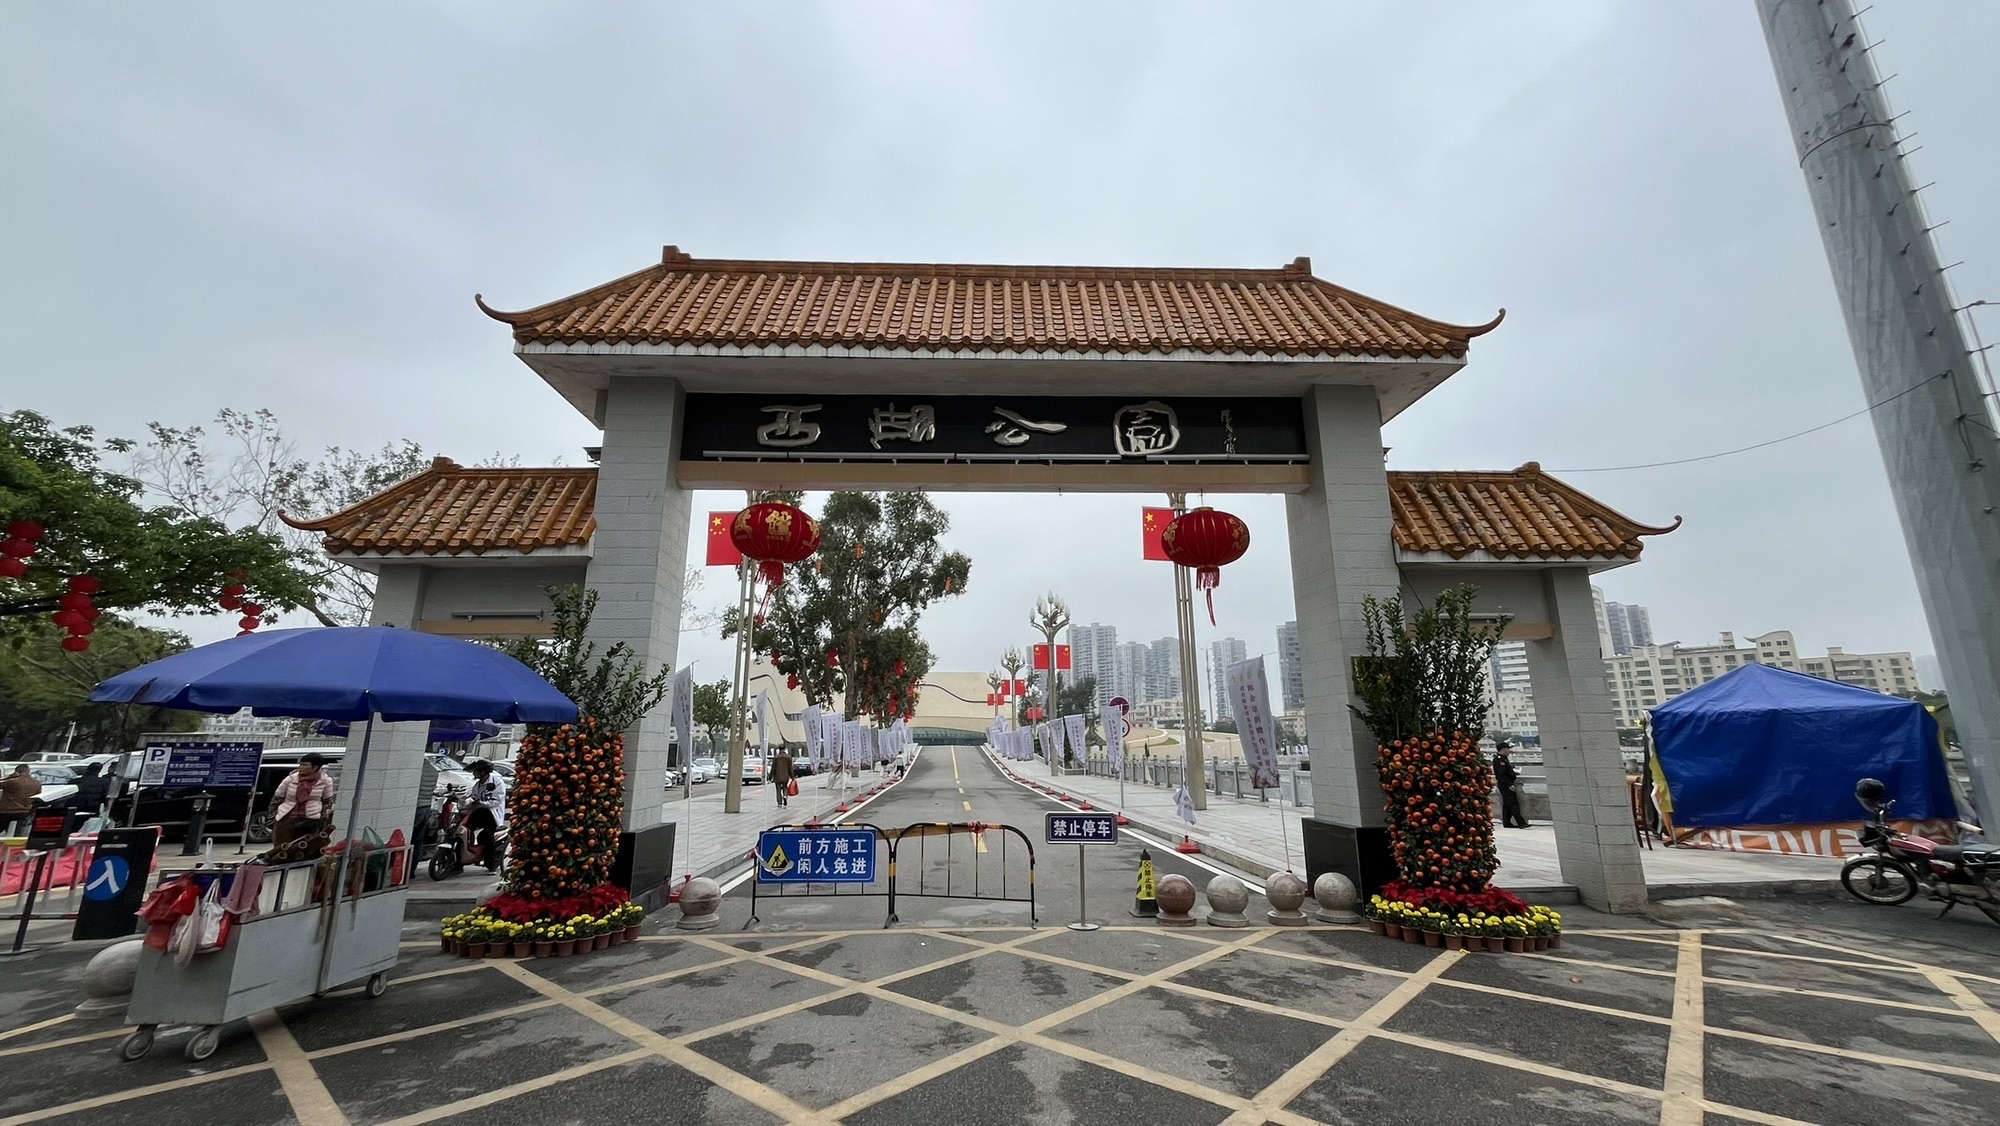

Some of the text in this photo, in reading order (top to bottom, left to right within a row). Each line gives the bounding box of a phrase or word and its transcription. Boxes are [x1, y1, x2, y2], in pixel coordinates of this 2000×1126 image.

[150, 748, 165, 762] P
[1053, 819, 1111, 837] 禁止停车
[797, 837, 867, 855] 前方施工
[797, 857, 867, 875] 闲人免进
[1144, 869, 1153, 898] 禁止停车
